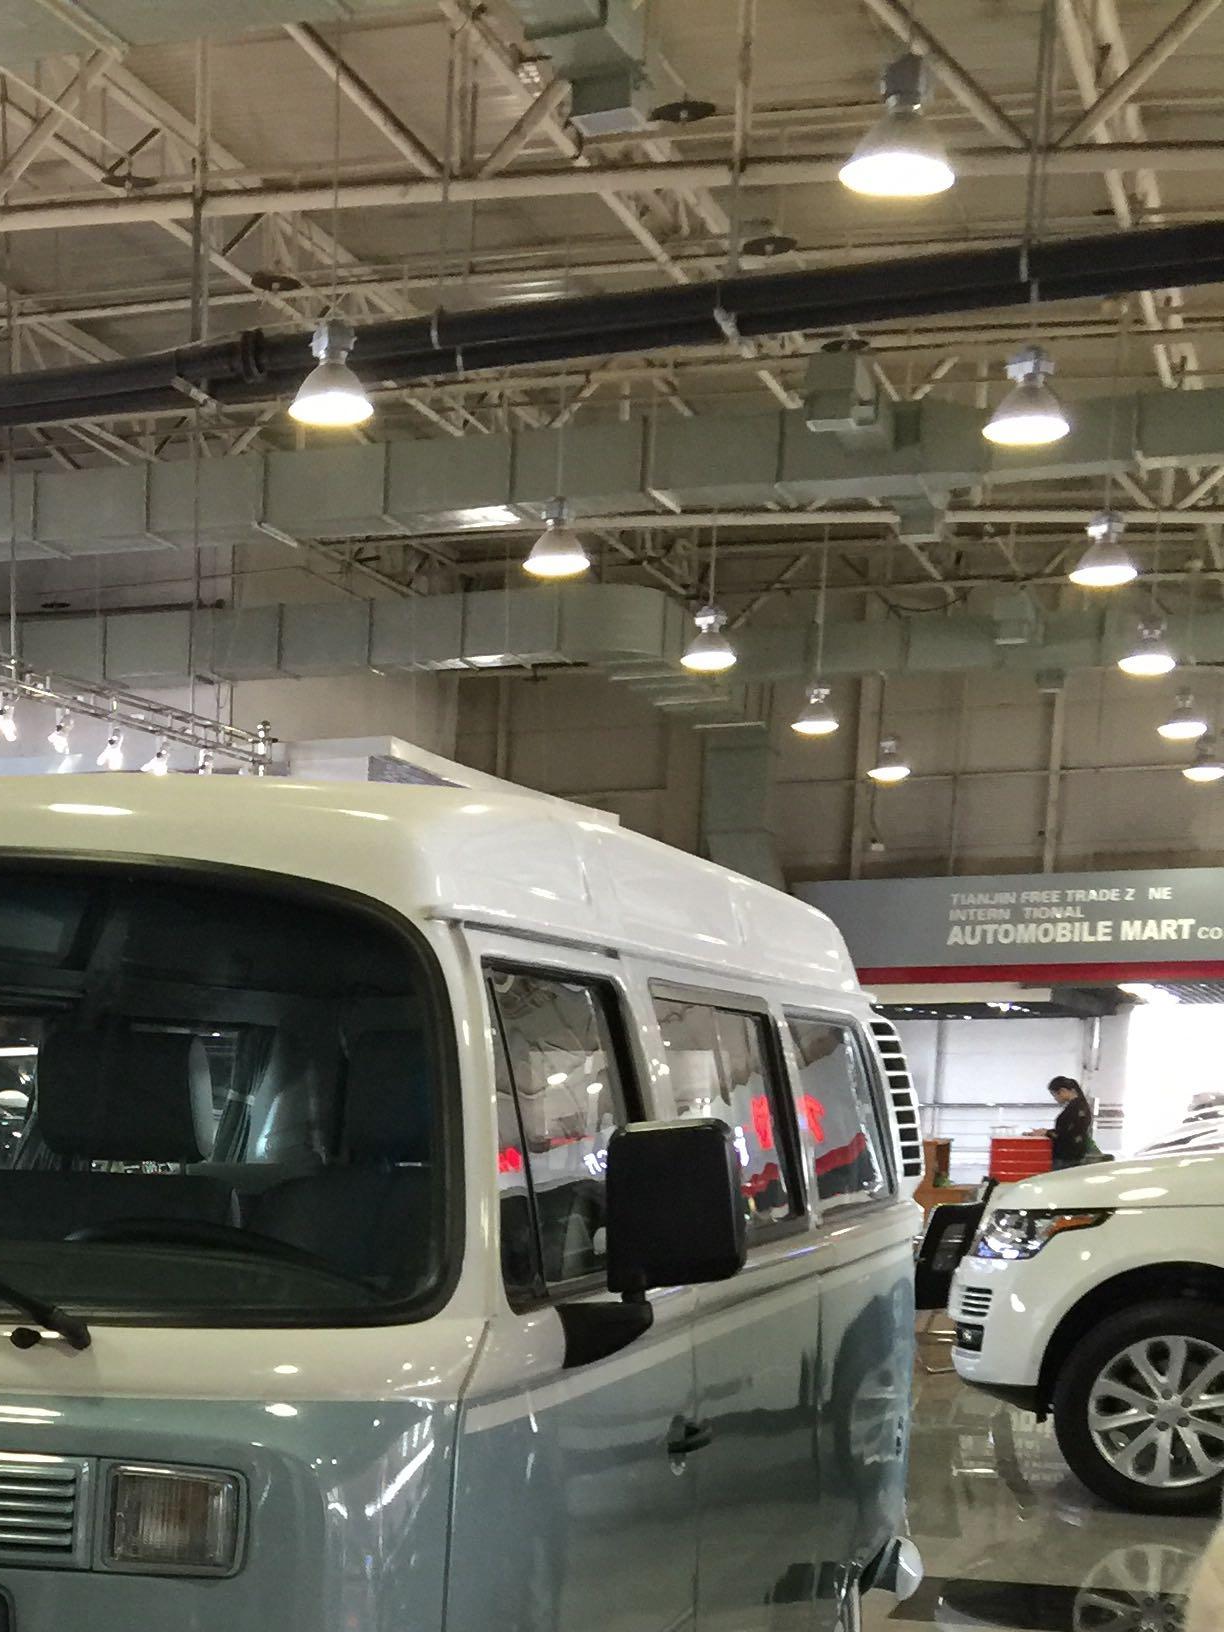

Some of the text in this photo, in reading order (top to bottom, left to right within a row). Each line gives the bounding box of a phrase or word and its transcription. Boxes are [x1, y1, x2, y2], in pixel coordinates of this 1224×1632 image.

[950, 892, 1017, 906] TIANJIN
[1019, 890, 1062, 904] FREE
[1065, 888, 1121, 903] TRADE
[946, 920, 1113, 946] AUTOMOBILE
[1119, 918, 1196, 941] MART
